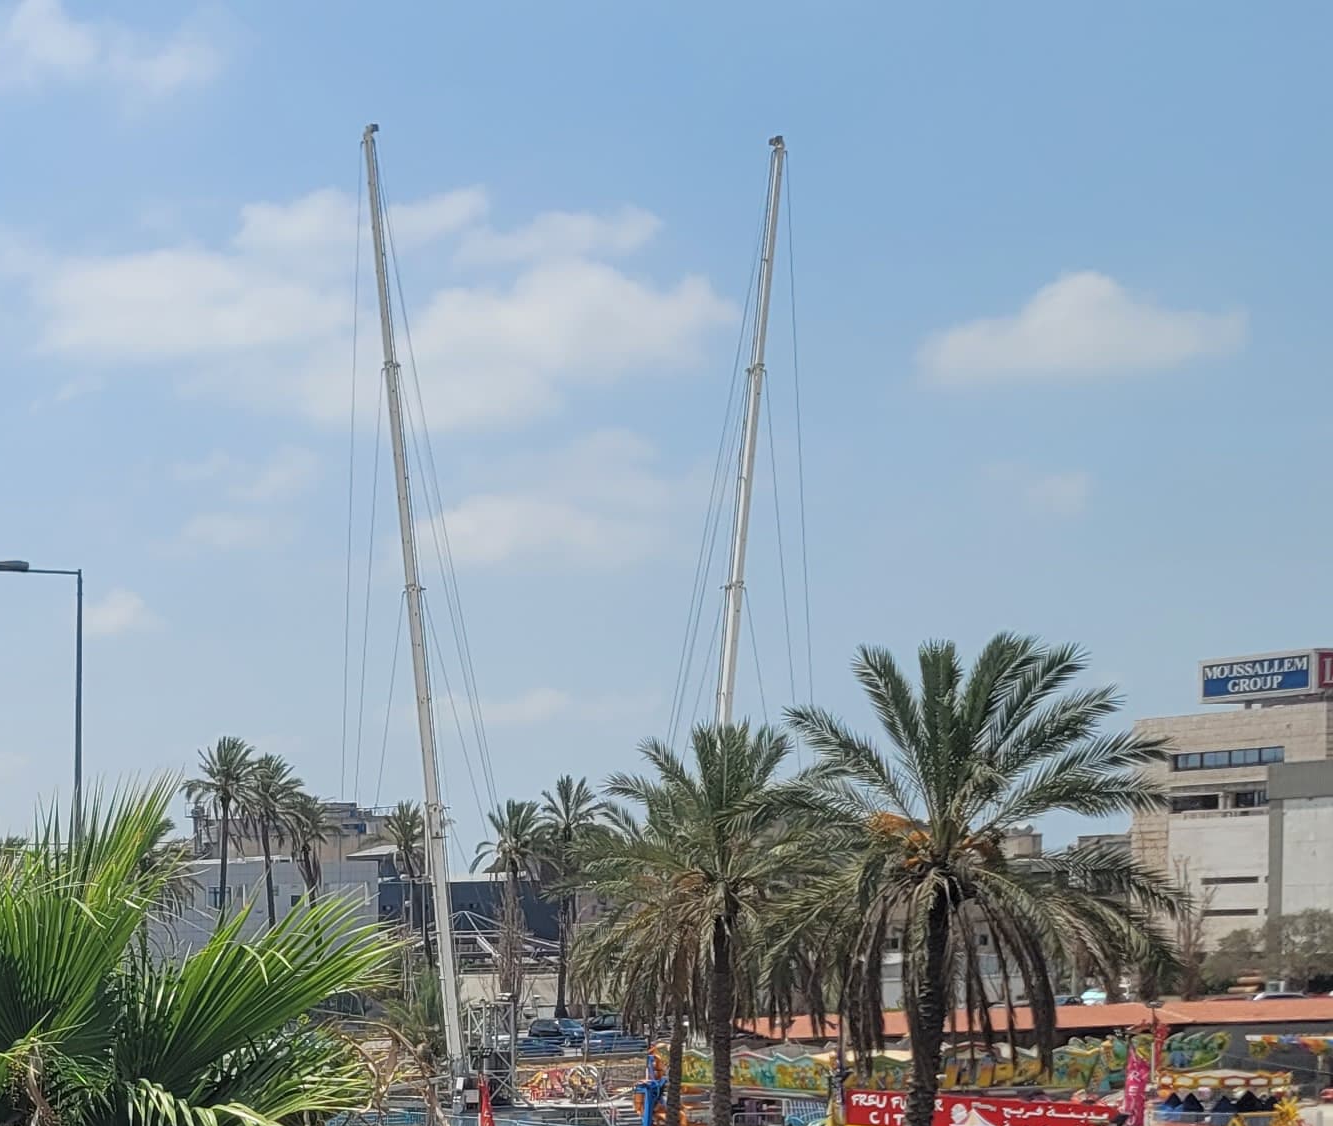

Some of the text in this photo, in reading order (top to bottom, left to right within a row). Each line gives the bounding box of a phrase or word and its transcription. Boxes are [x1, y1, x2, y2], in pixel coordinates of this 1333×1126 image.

[1204, 657, 1308, 681] MOUSSALLEM
[1227, 675, 1283, 693] GROUP
[869, 1112, 905, 1126] CIT
